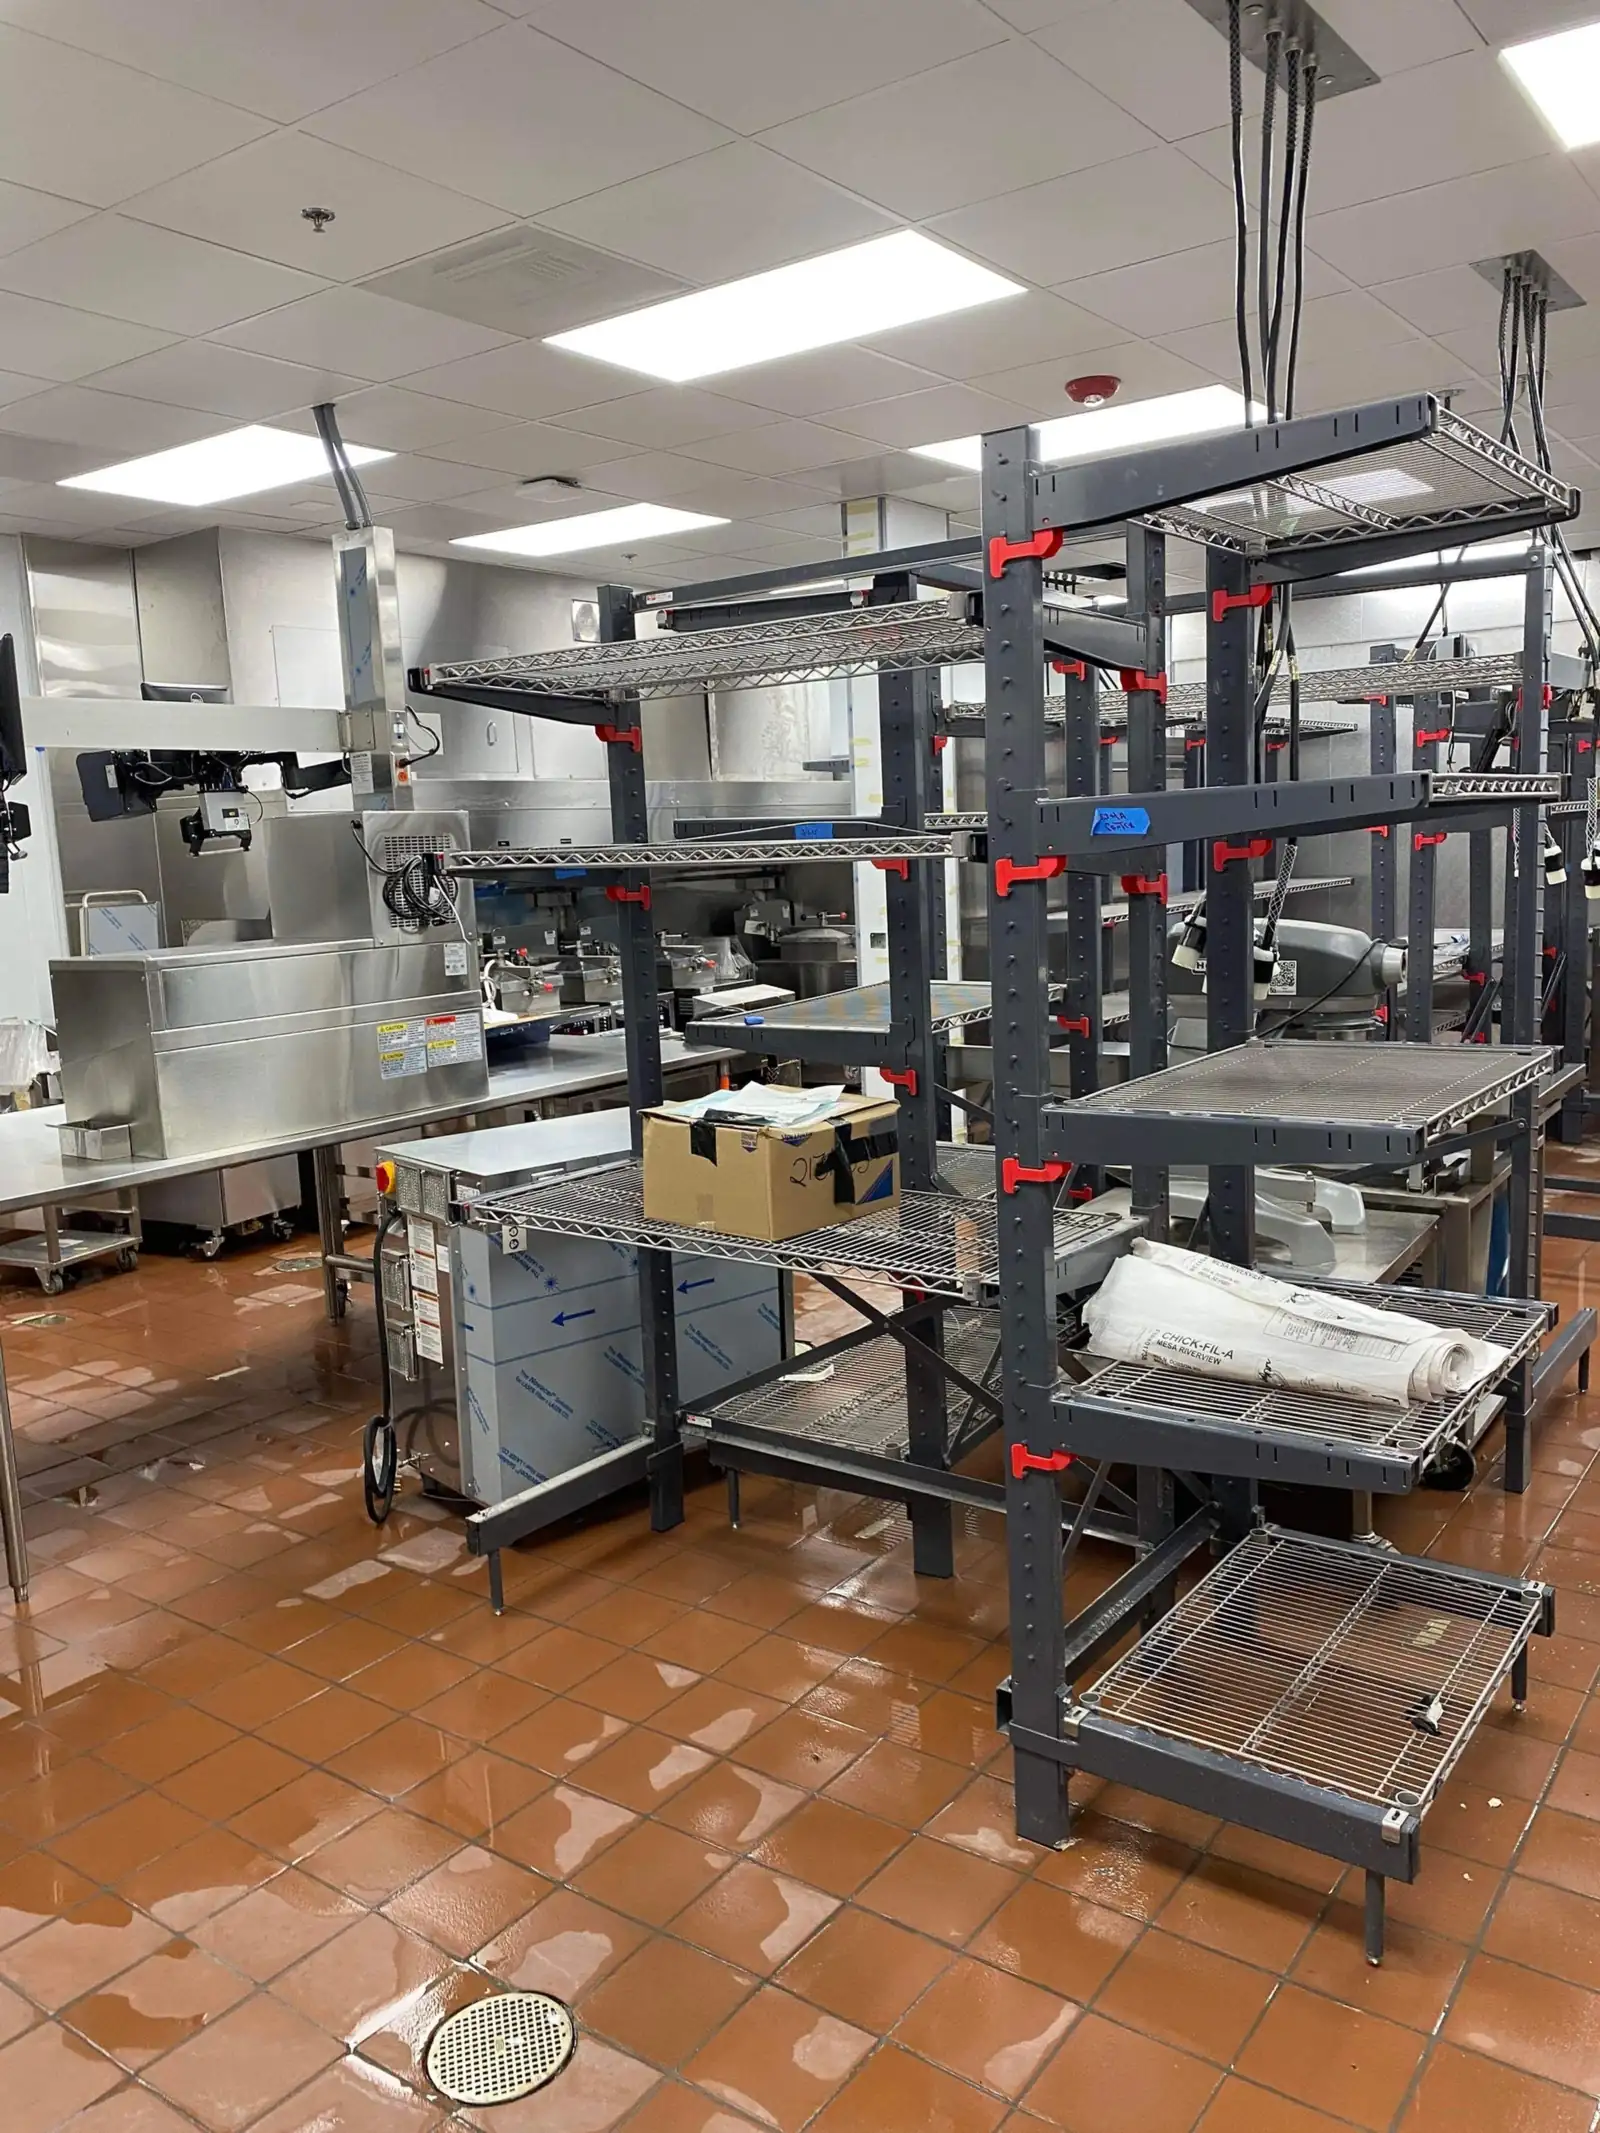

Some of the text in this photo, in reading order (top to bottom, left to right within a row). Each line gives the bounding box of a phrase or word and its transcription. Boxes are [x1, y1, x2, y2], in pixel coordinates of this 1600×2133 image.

[1156, 1339, 1222, 1365] MESA RIVERVIEW
[1161, 1331, 1235, 1360] CHICK-FIL-A
